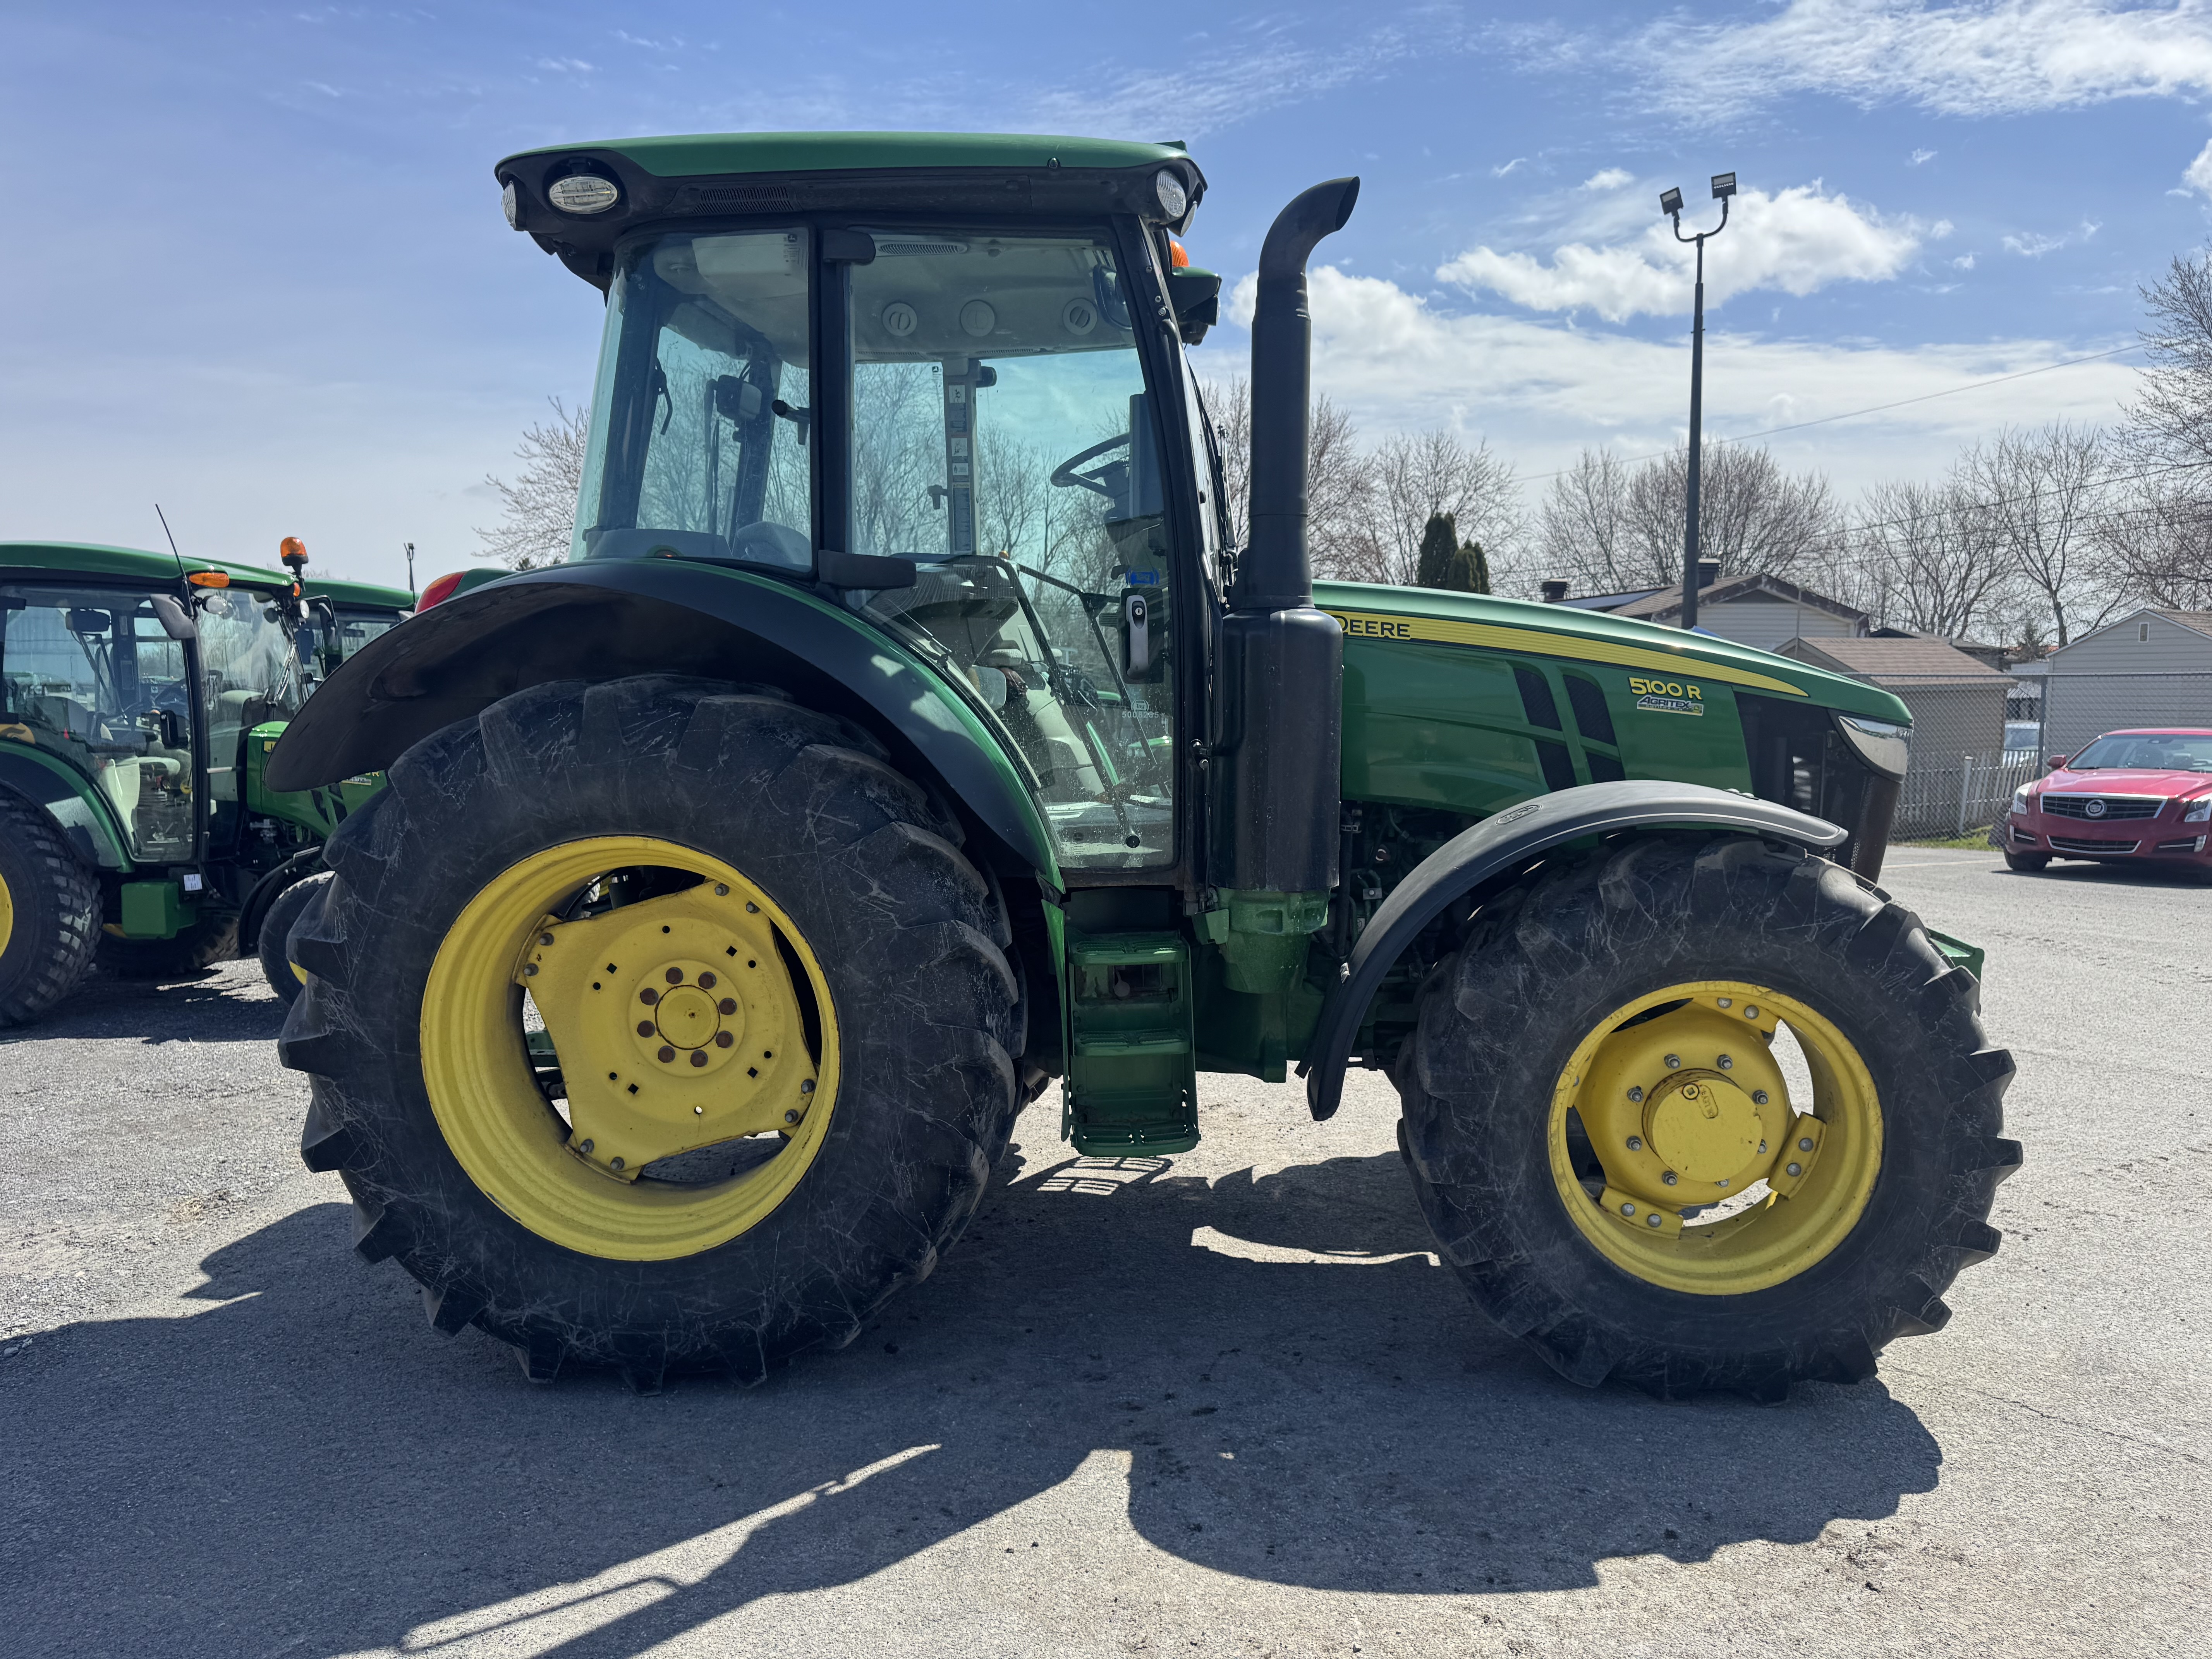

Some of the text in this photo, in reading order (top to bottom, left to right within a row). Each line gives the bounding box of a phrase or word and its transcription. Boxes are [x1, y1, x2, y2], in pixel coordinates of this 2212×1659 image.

[1629, 677, 1702, 700] 5100 R
[1639, 696, 1692, 708] AGRITEX
